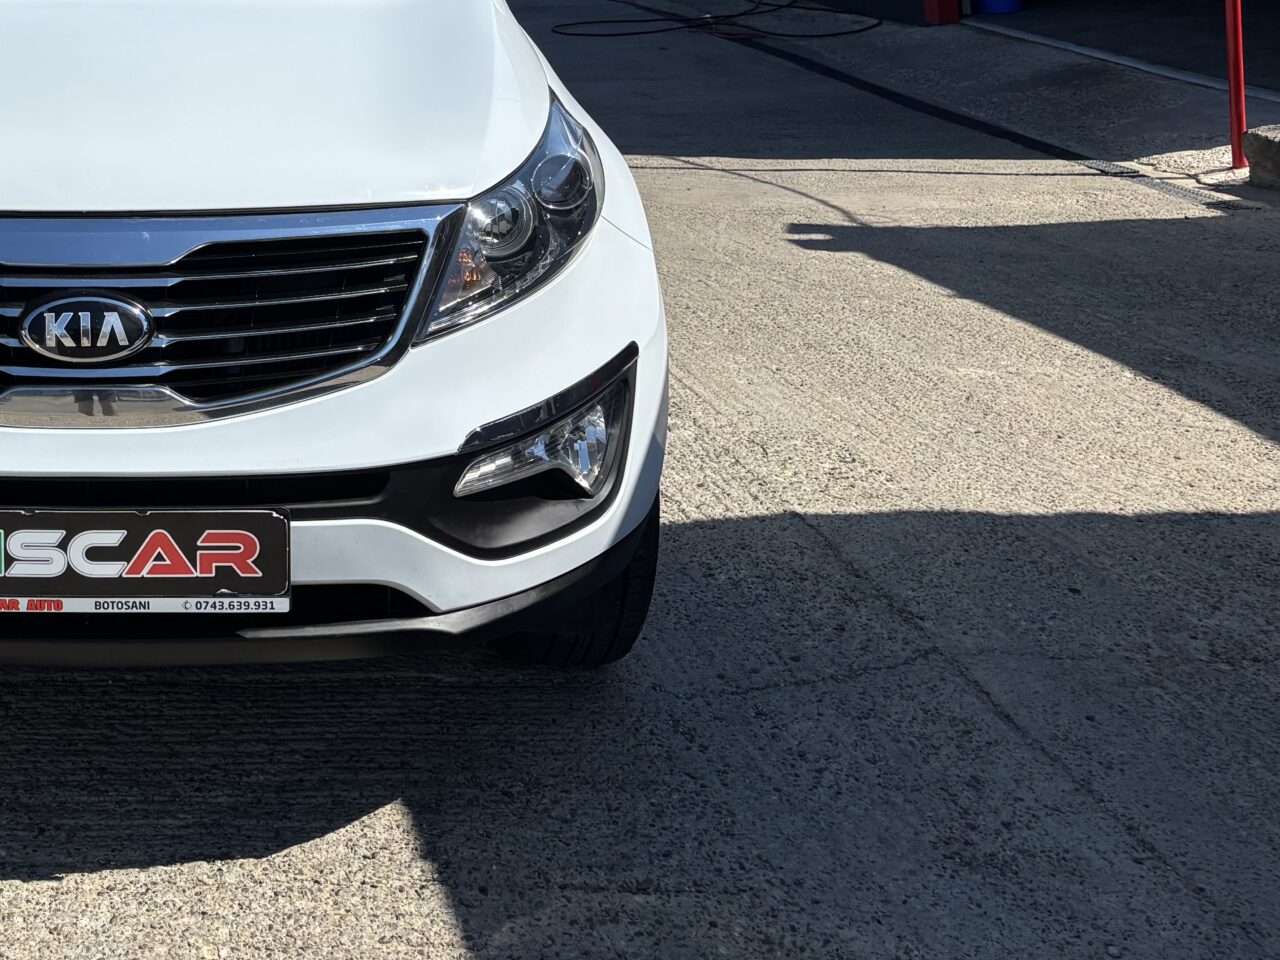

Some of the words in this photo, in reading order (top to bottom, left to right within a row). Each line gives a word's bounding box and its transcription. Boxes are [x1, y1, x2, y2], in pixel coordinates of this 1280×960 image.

[43, 311, 130, 347] KIA
[26, 599, 64, 611] AUTO
[94, 600, 150, 611] BOTOSANI
[195, 600, 276, 611] 0743.639.931
